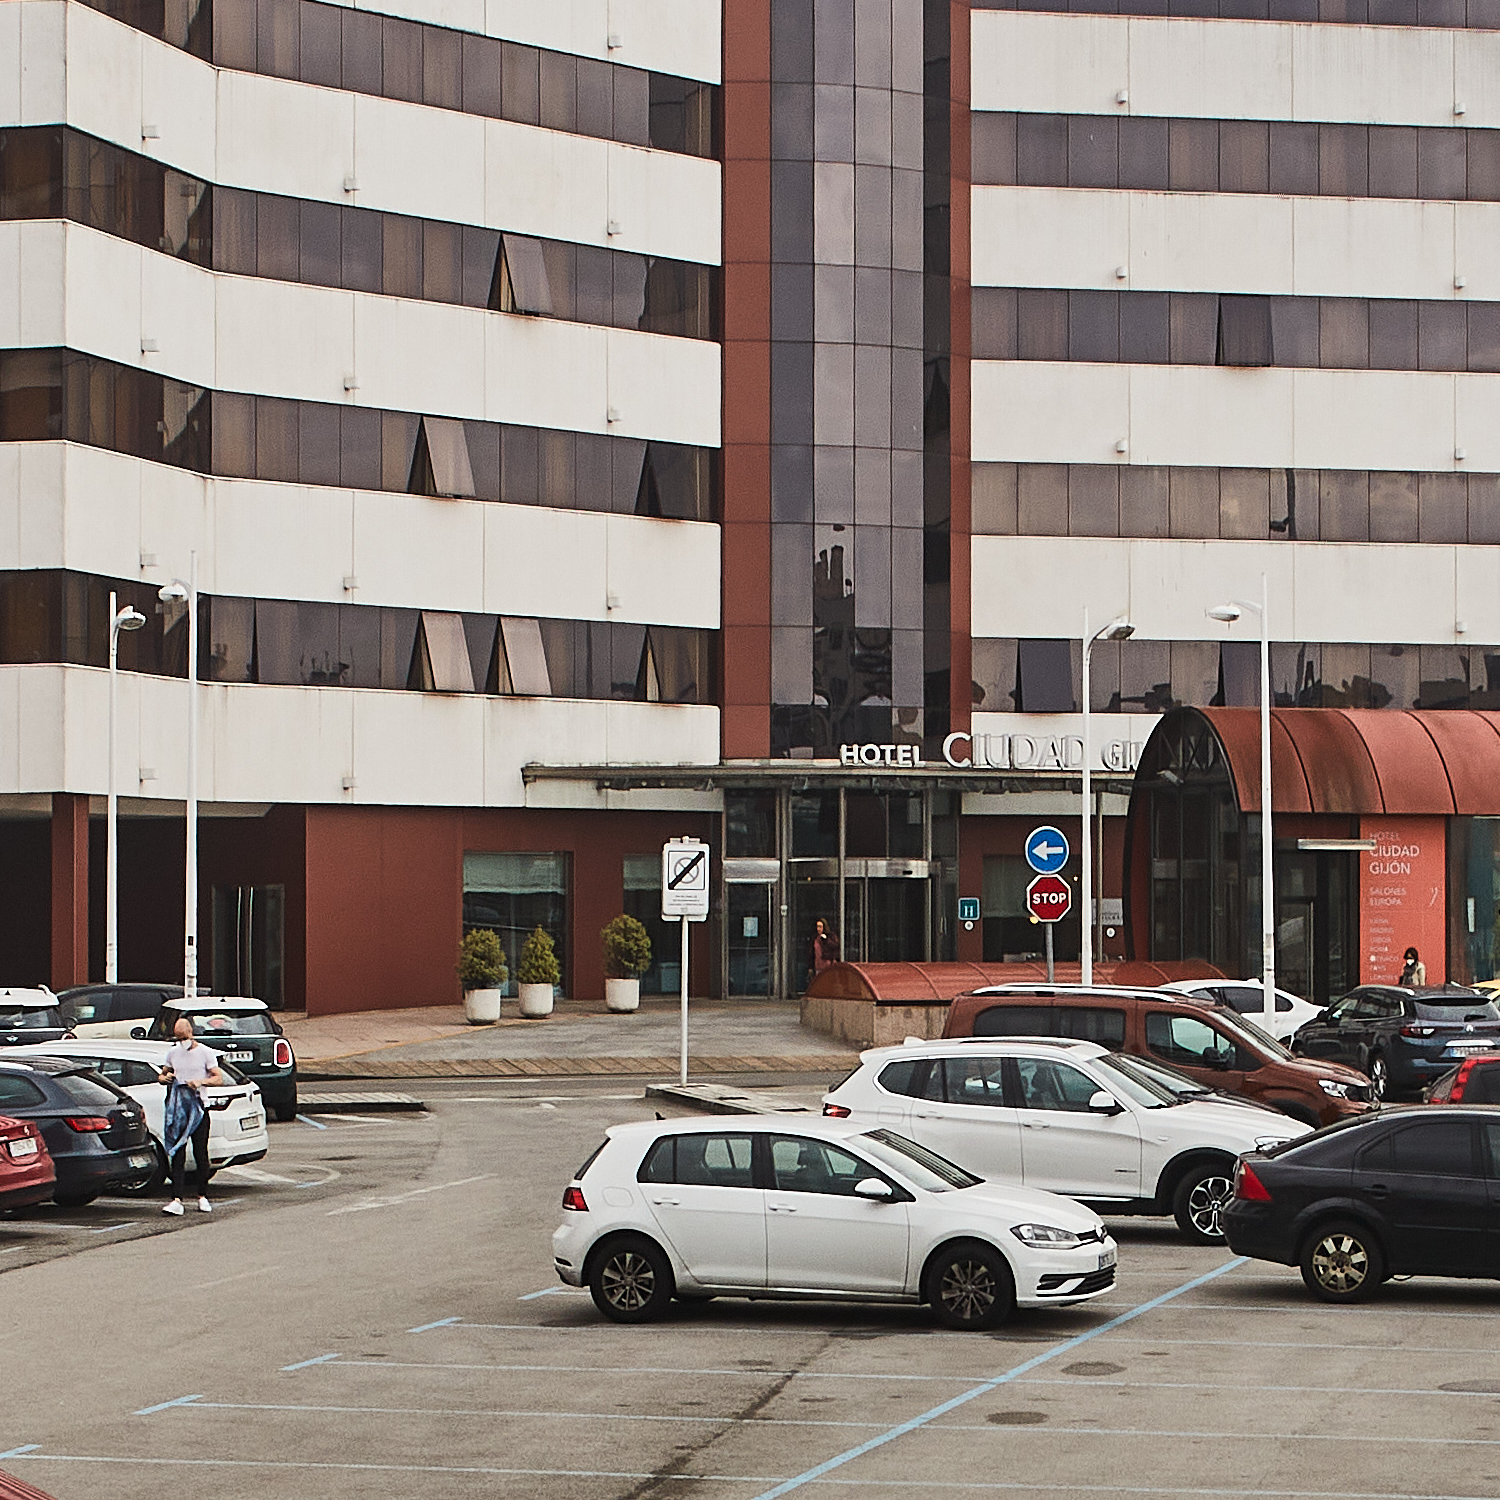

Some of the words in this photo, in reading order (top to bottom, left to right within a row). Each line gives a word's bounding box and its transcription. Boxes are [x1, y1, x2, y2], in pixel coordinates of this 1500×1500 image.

[840, 743, 926, 768] HOTEL
[942, 731, 1085, 771] CIUDAD
[1369, 860, 1411, 875] GIJÓN
[1032, 892, 1067, 905] STOP
